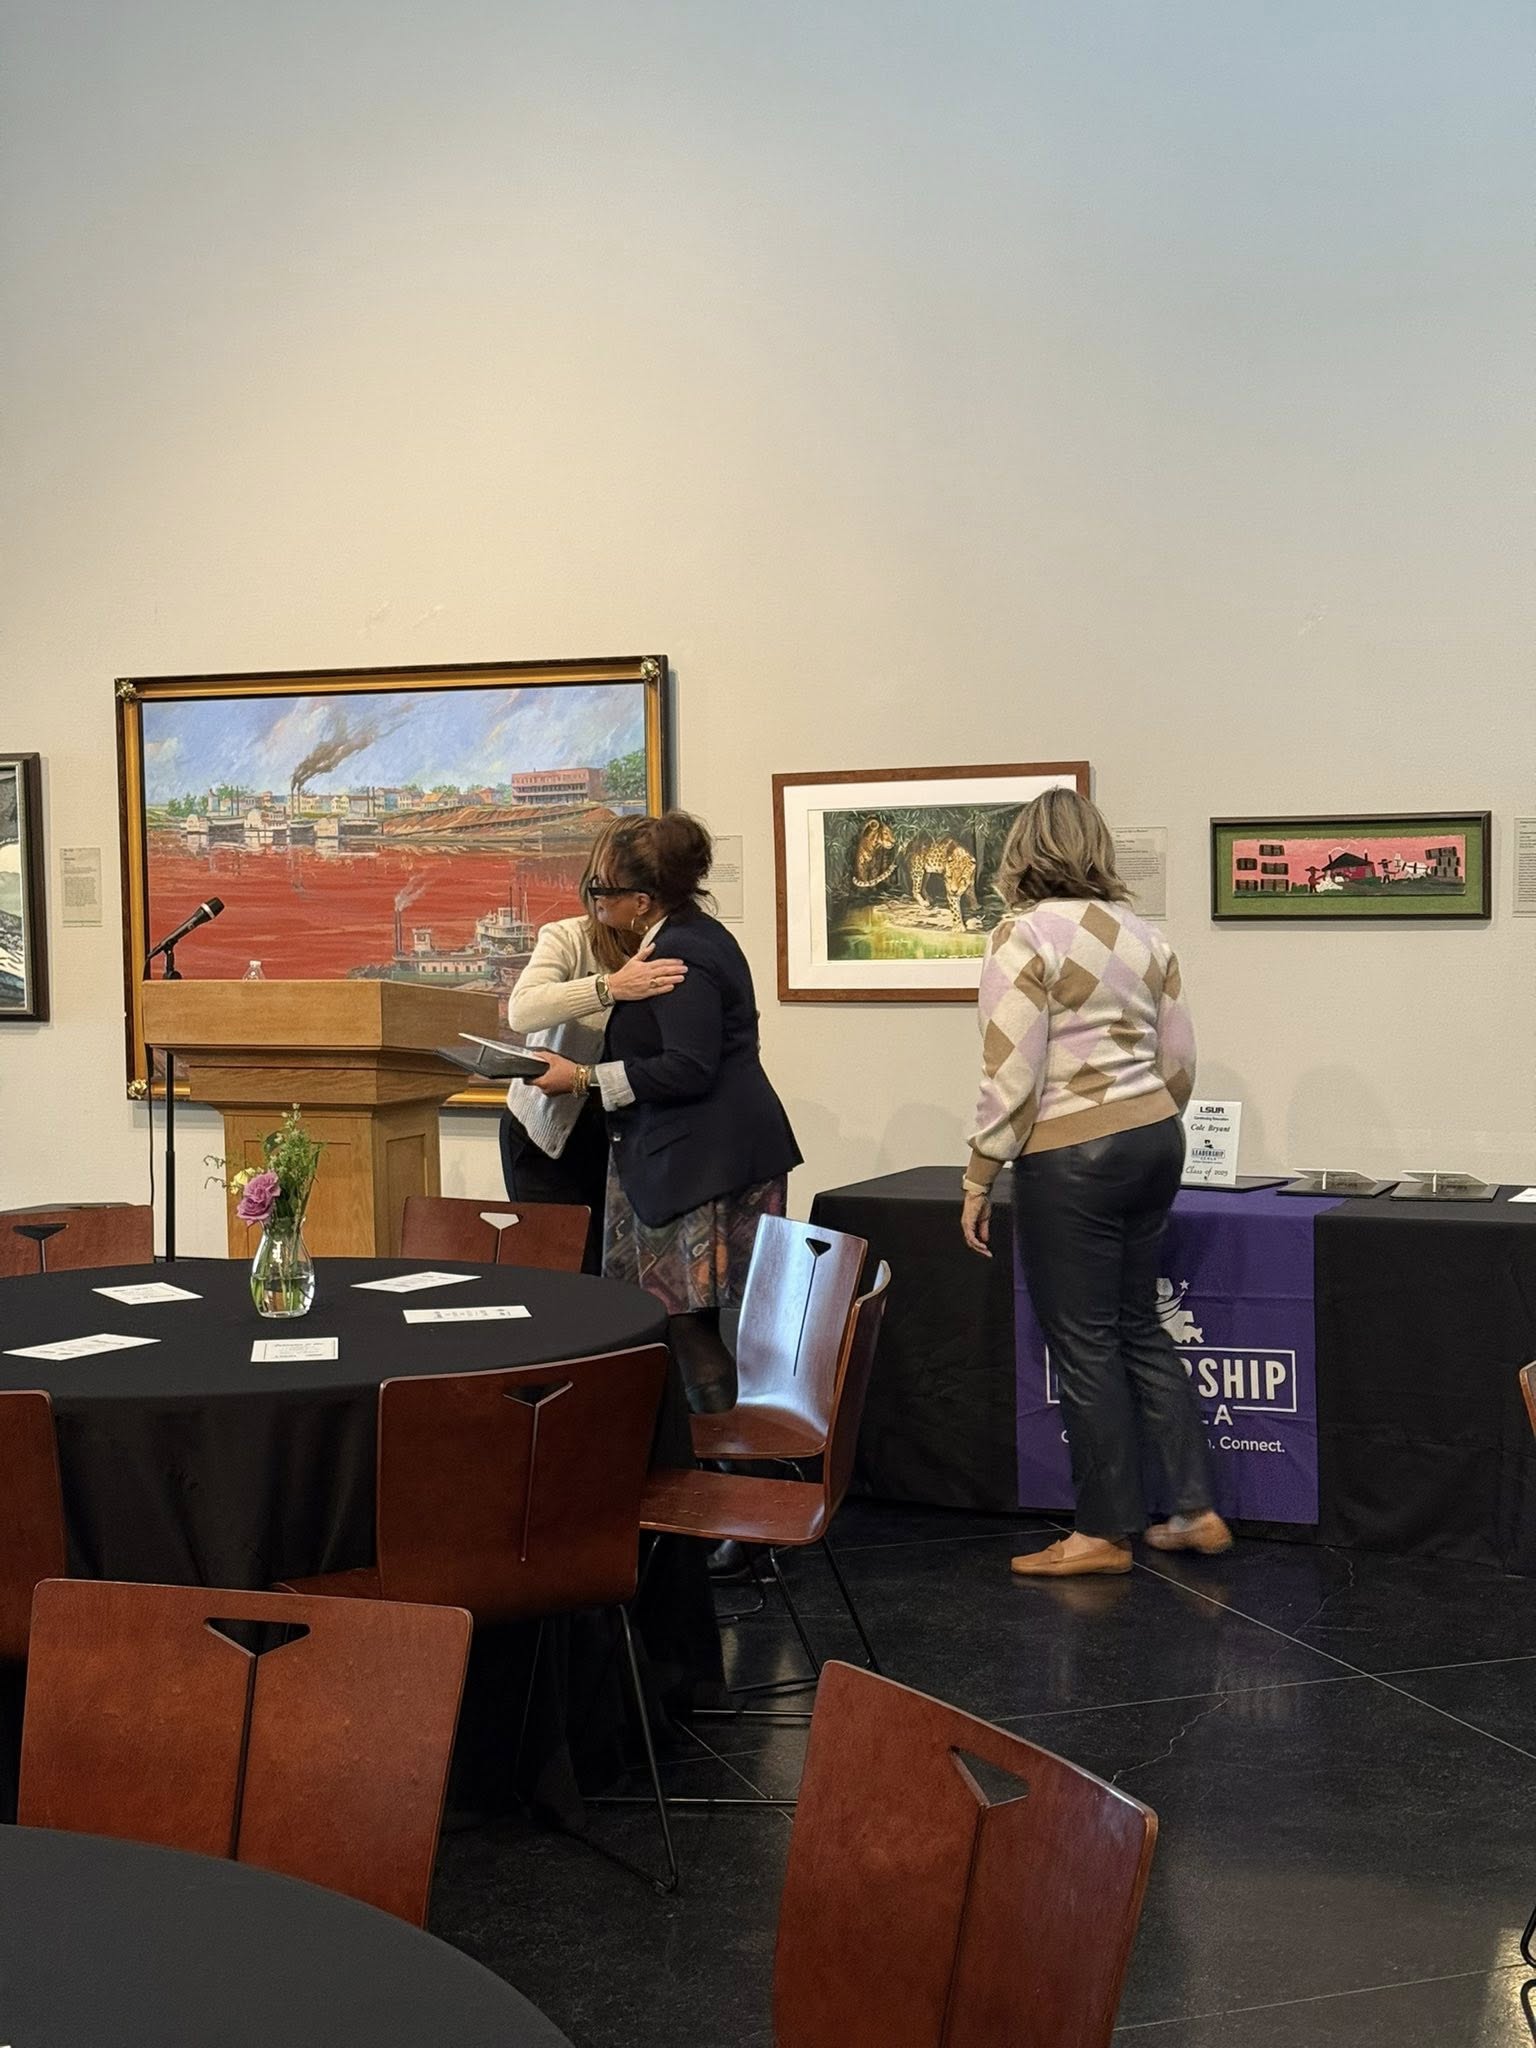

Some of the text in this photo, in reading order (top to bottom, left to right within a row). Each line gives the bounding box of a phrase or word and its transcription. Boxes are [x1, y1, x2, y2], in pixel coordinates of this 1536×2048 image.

[1208, 1124, 1231, 1133] Bryant
[1185, 1166, 1203, 1175] Class
[1205, 1166, 1213, 1177] of
[1220, 1435, 1285, 1453] Connect.
